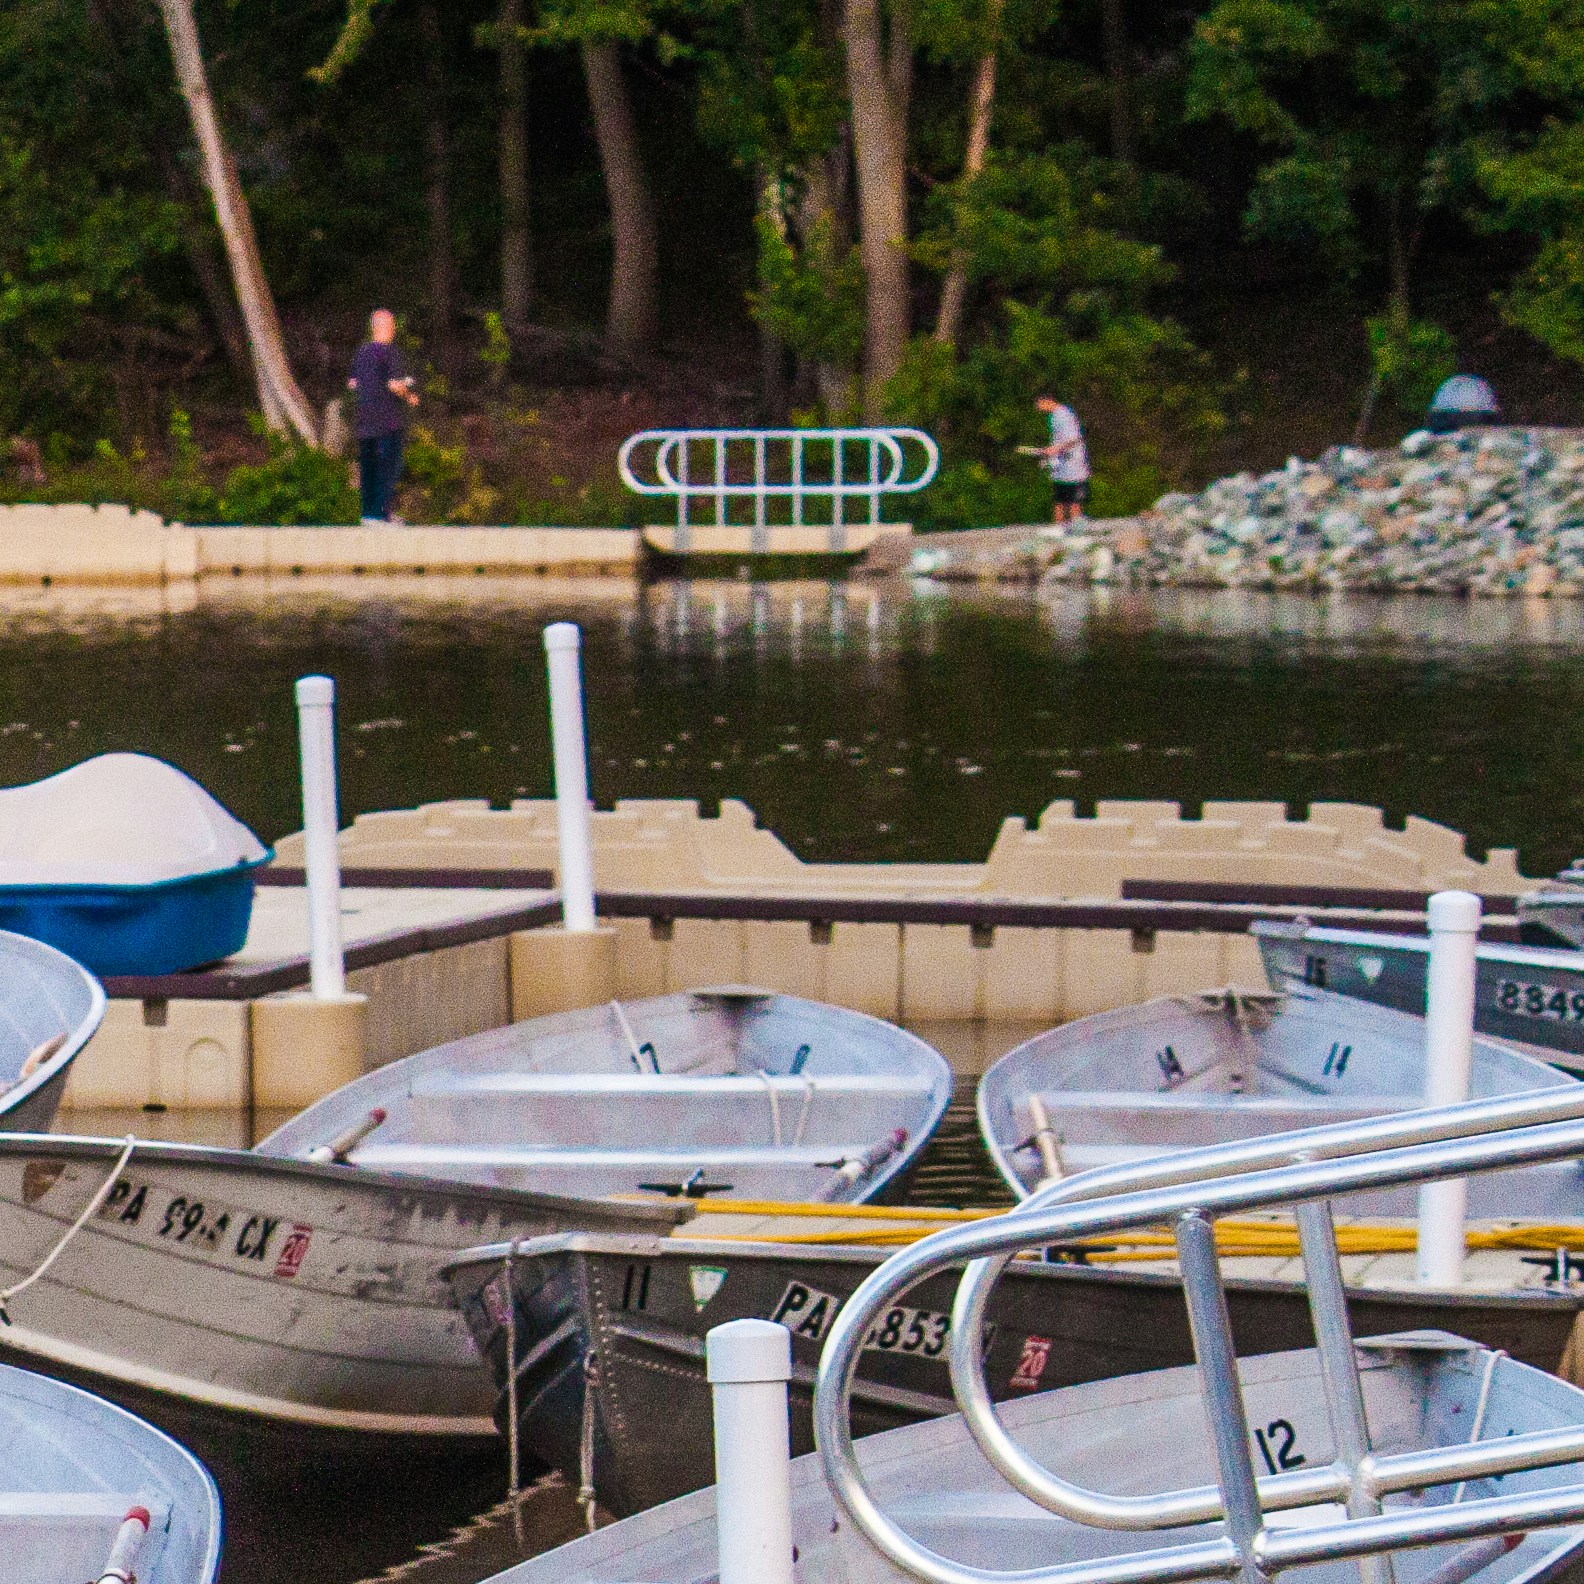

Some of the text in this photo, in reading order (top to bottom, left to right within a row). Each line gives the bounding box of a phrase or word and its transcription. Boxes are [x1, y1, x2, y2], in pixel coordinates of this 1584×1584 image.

[236, 1216, 282, 1262] CX
[772, 1282, 830, 1339] PA
[868, 1305, 951, 1357] 853
[1255, 1418, 1307, 1476] 12
